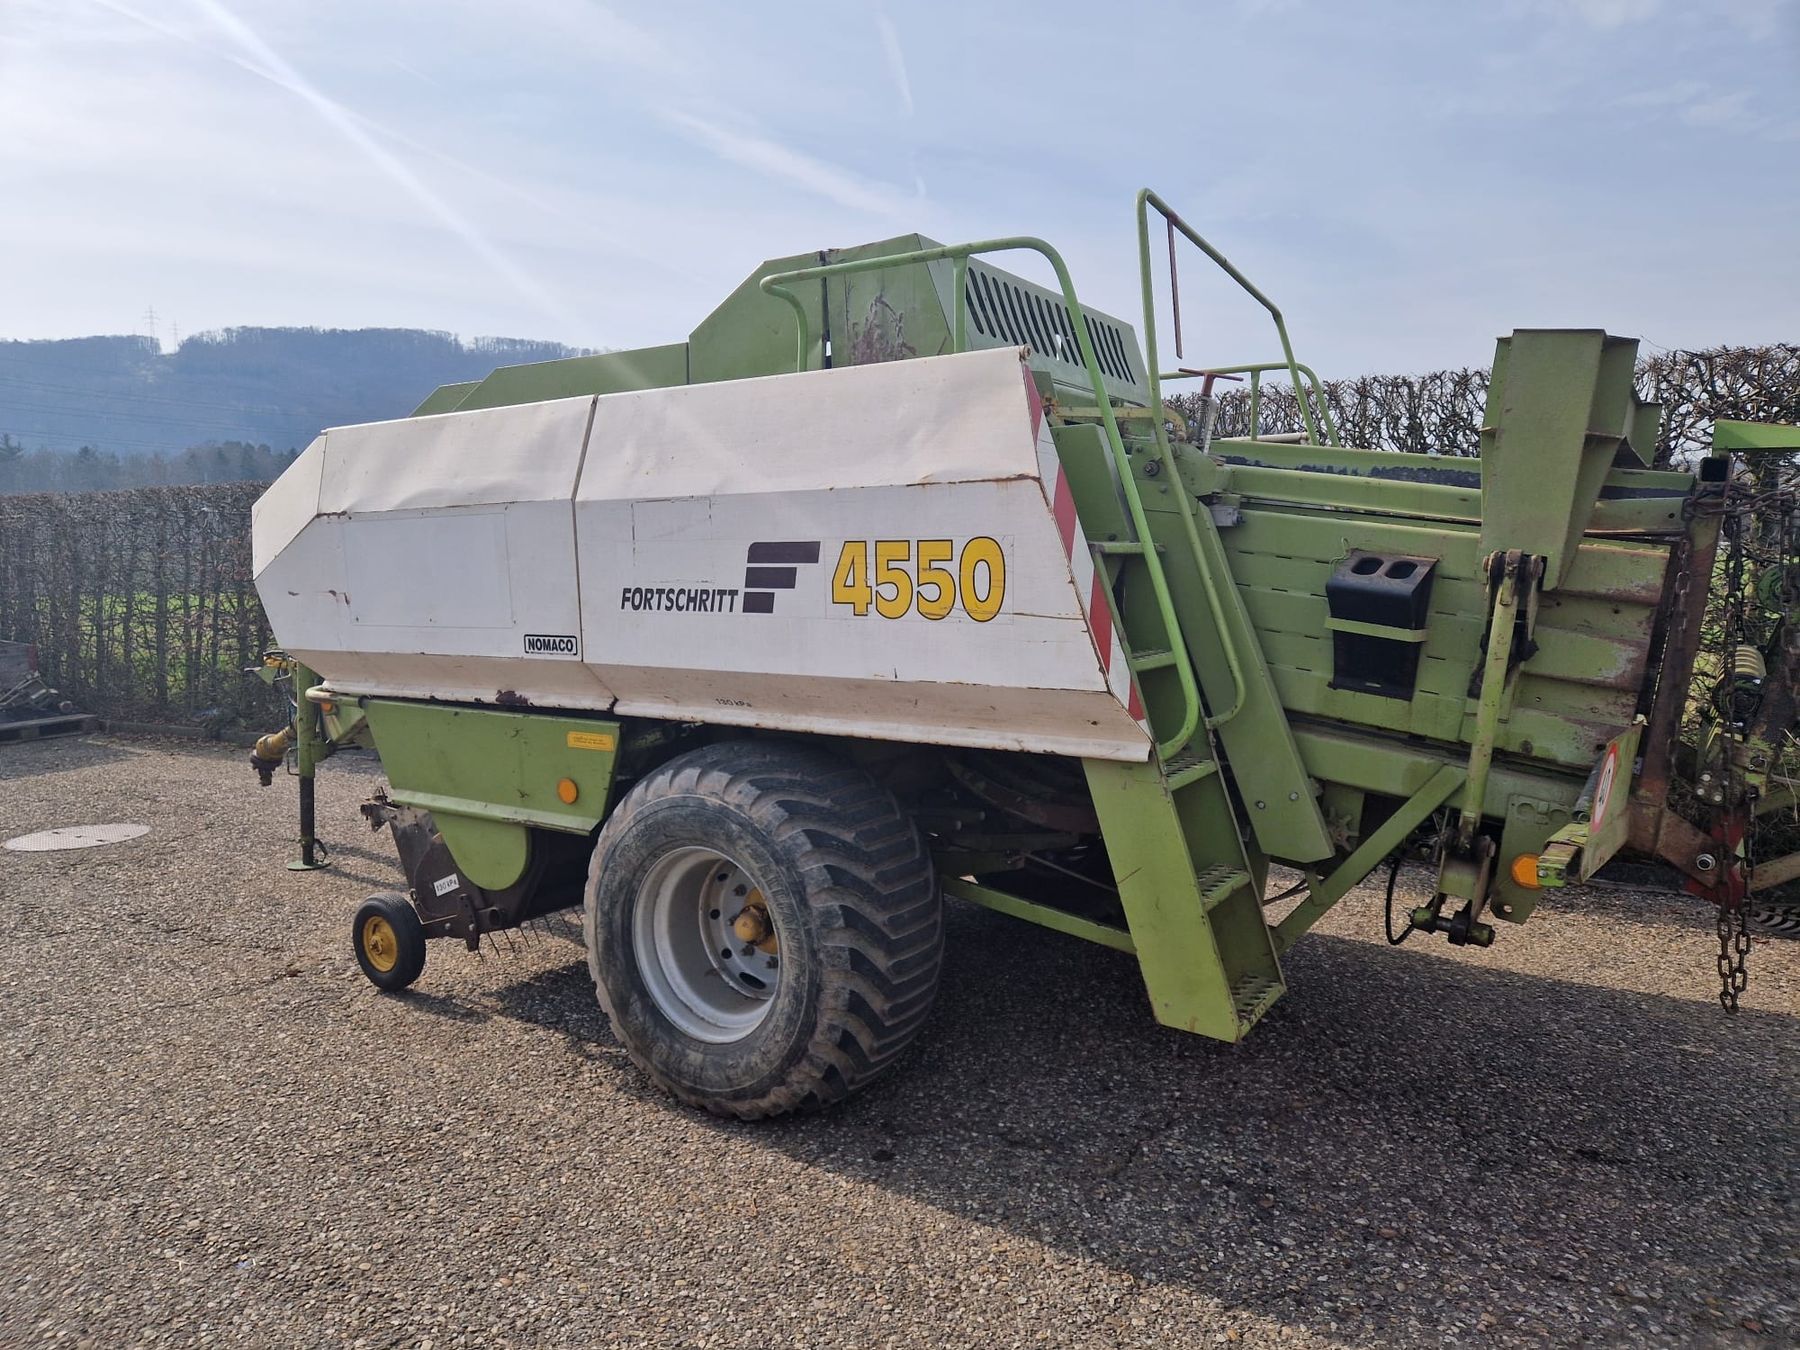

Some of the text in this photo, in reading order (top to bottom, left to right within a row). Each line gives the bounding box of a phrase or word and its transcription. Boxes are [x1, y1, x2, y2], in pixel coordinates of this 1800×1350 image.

[832, 536, 1006, 623] 4550
[621, 587, 739, 613] FORTSCHRITT
[528, 638, 573, 652] NOMACO
